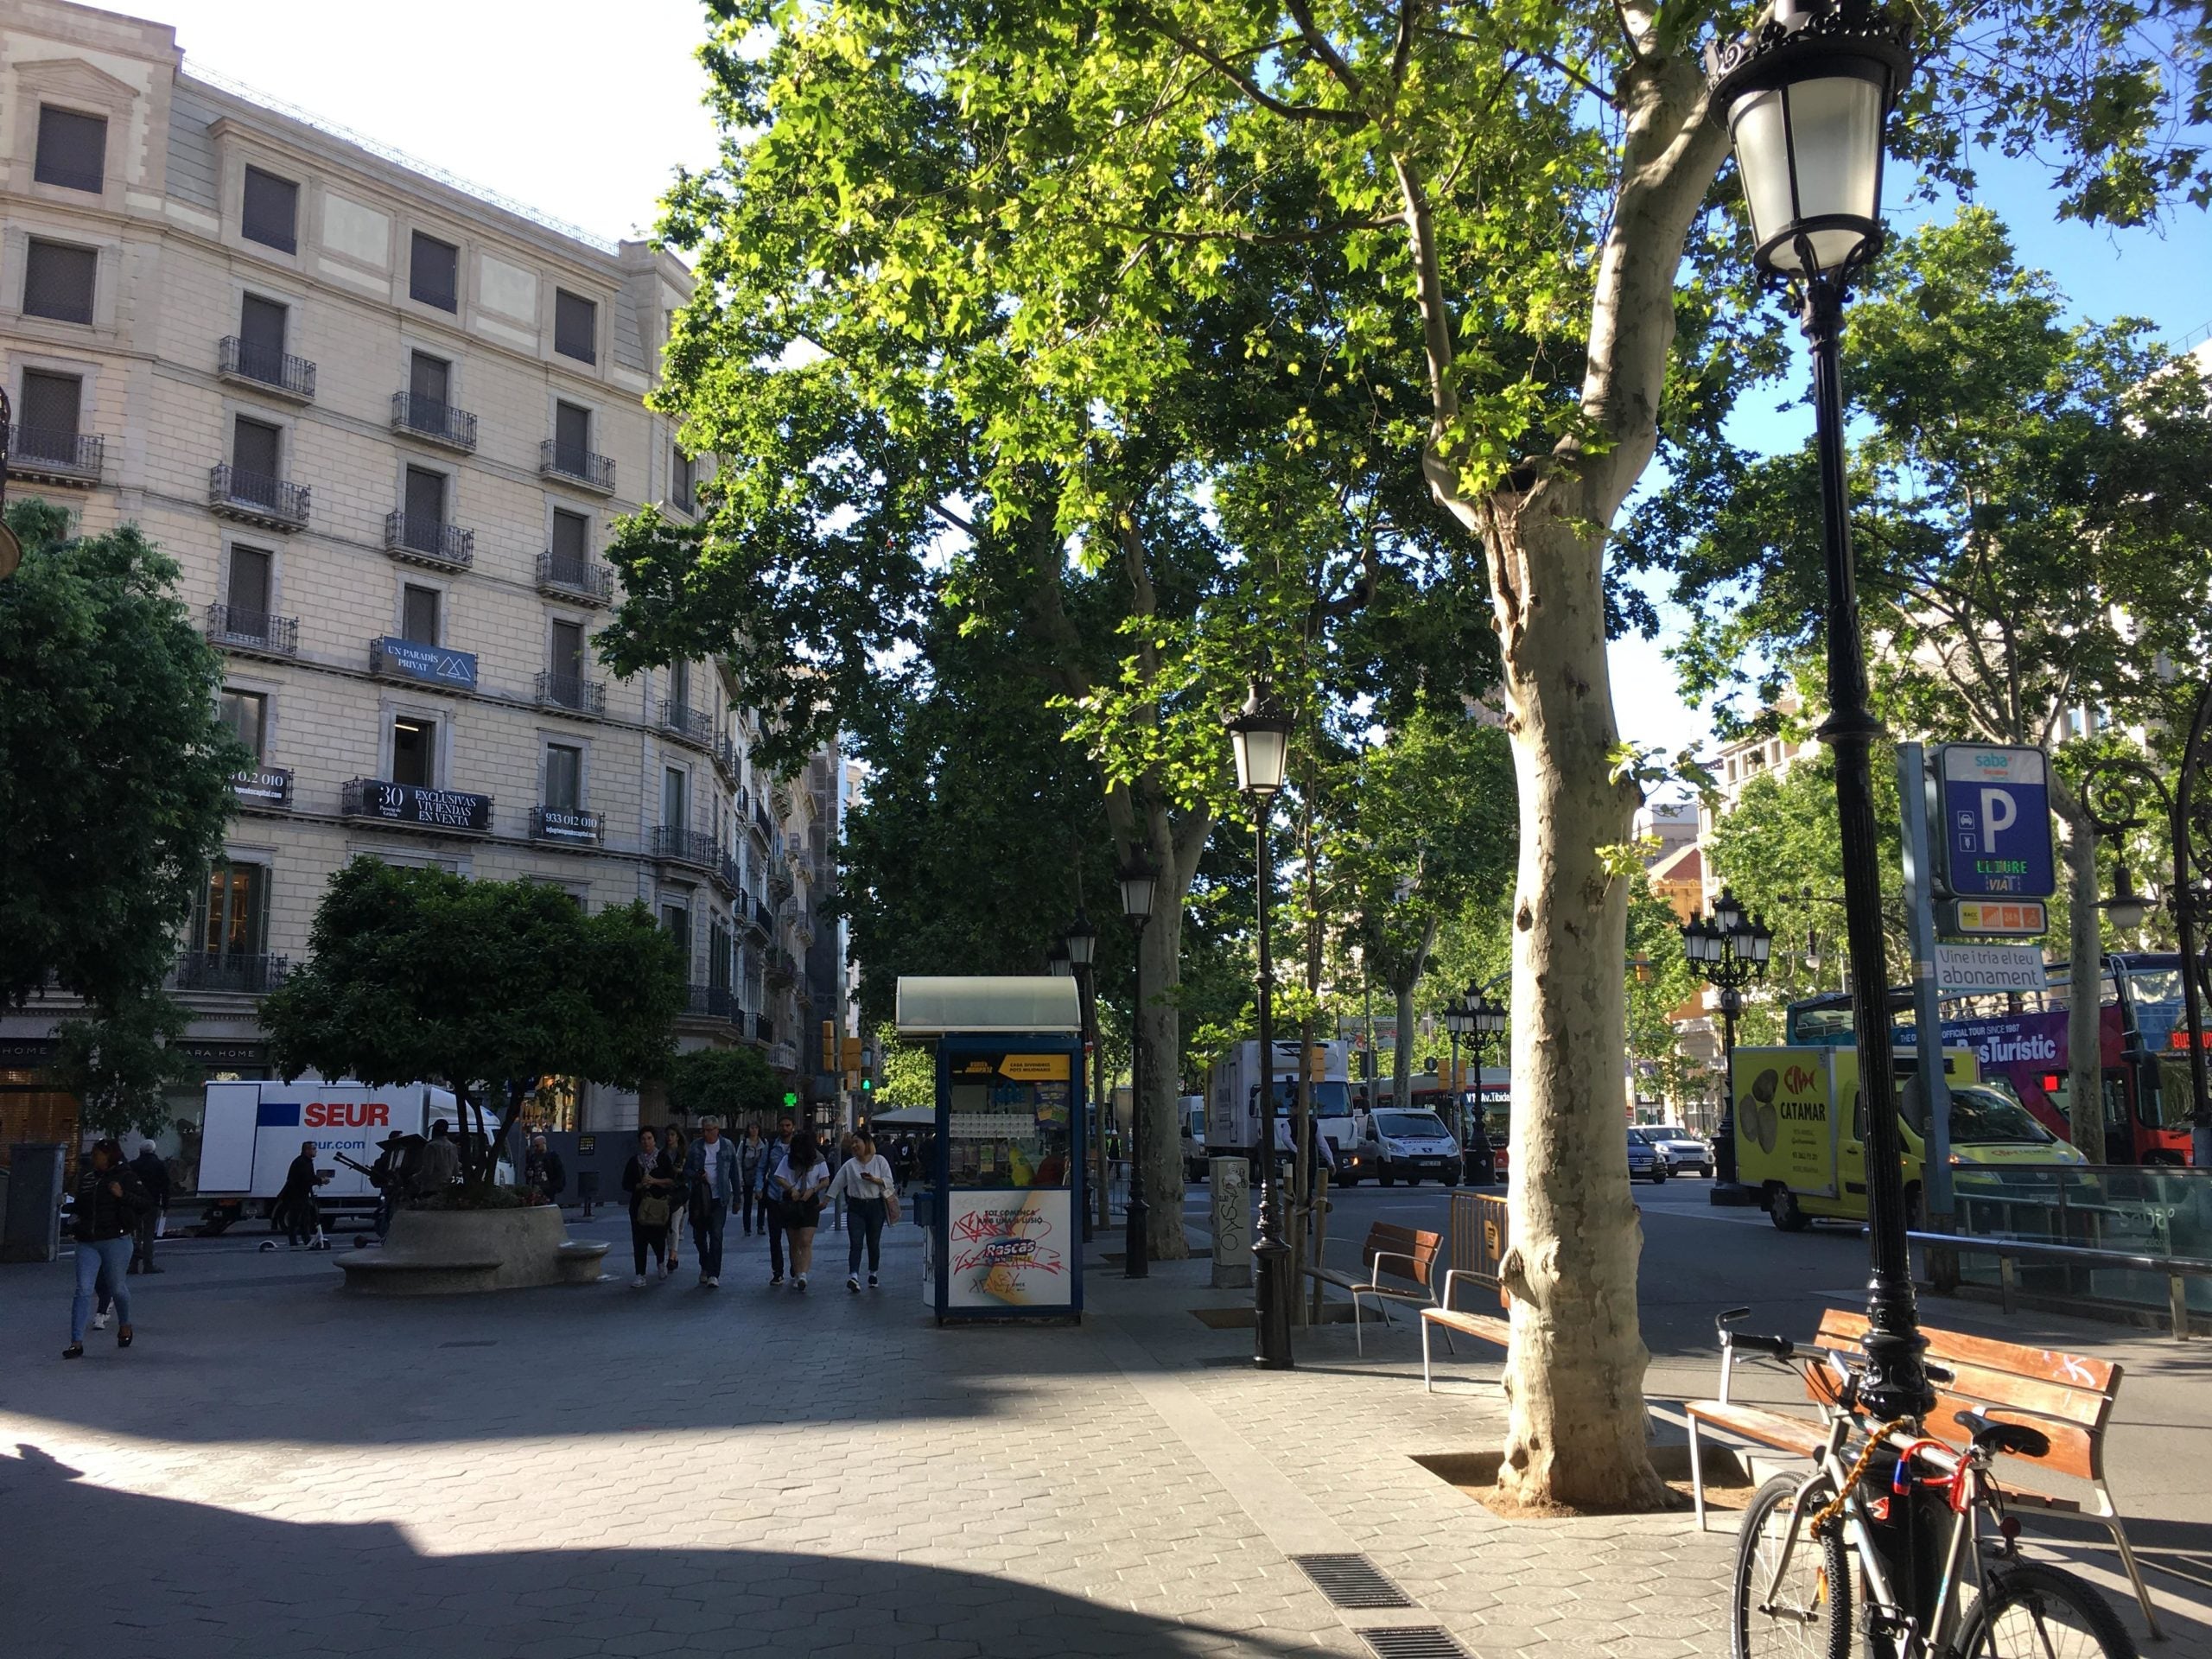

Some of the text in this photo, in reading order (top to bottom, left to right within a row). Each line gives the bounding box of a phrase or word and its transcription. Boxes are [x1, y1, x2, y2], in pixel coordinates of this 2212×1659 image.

[388, 645, 402, 656] UN
[398, 658, 428, 671] PRIVAT
[1975, 753, 2008, 767] saba
[261, 774, 283, 787] 010
[378, 785, 404, 806] 30
[415, 790, 476, 808] EXCLUSIVAS
[417, 800, 472, 817] VIVIENDAS
[419, 810, 469, 827] EN VENTA
[545, 812, 597, 828] 933 012 010
[1980, 788, 2017, 853] P
[1976, 860, 2027, 874] LLIURE
[1939, 949, 1969, 963] Vine
[1978, 951, 1999, 964] tria
[2001, 951, 2012, 964] el
[2014, 953, 2034, 965] teu
[1943, 966, 2039, 986] abonament
[1901, 1034, 1911, 1043] THE
[1942, 1027, 1968, 1039] OFFICIAL
[1968, 1026, 1986, 1036] TOUR
[1986, 1025, 2005, 1035] SINCE
[2, 1046, 48, 1055] HOME
[304, 1103, 390, 1128] SEUR
[1780, 1102, 1827, 1122] CATAMAR
[986, 1241, 1035, 1257] Rascas
